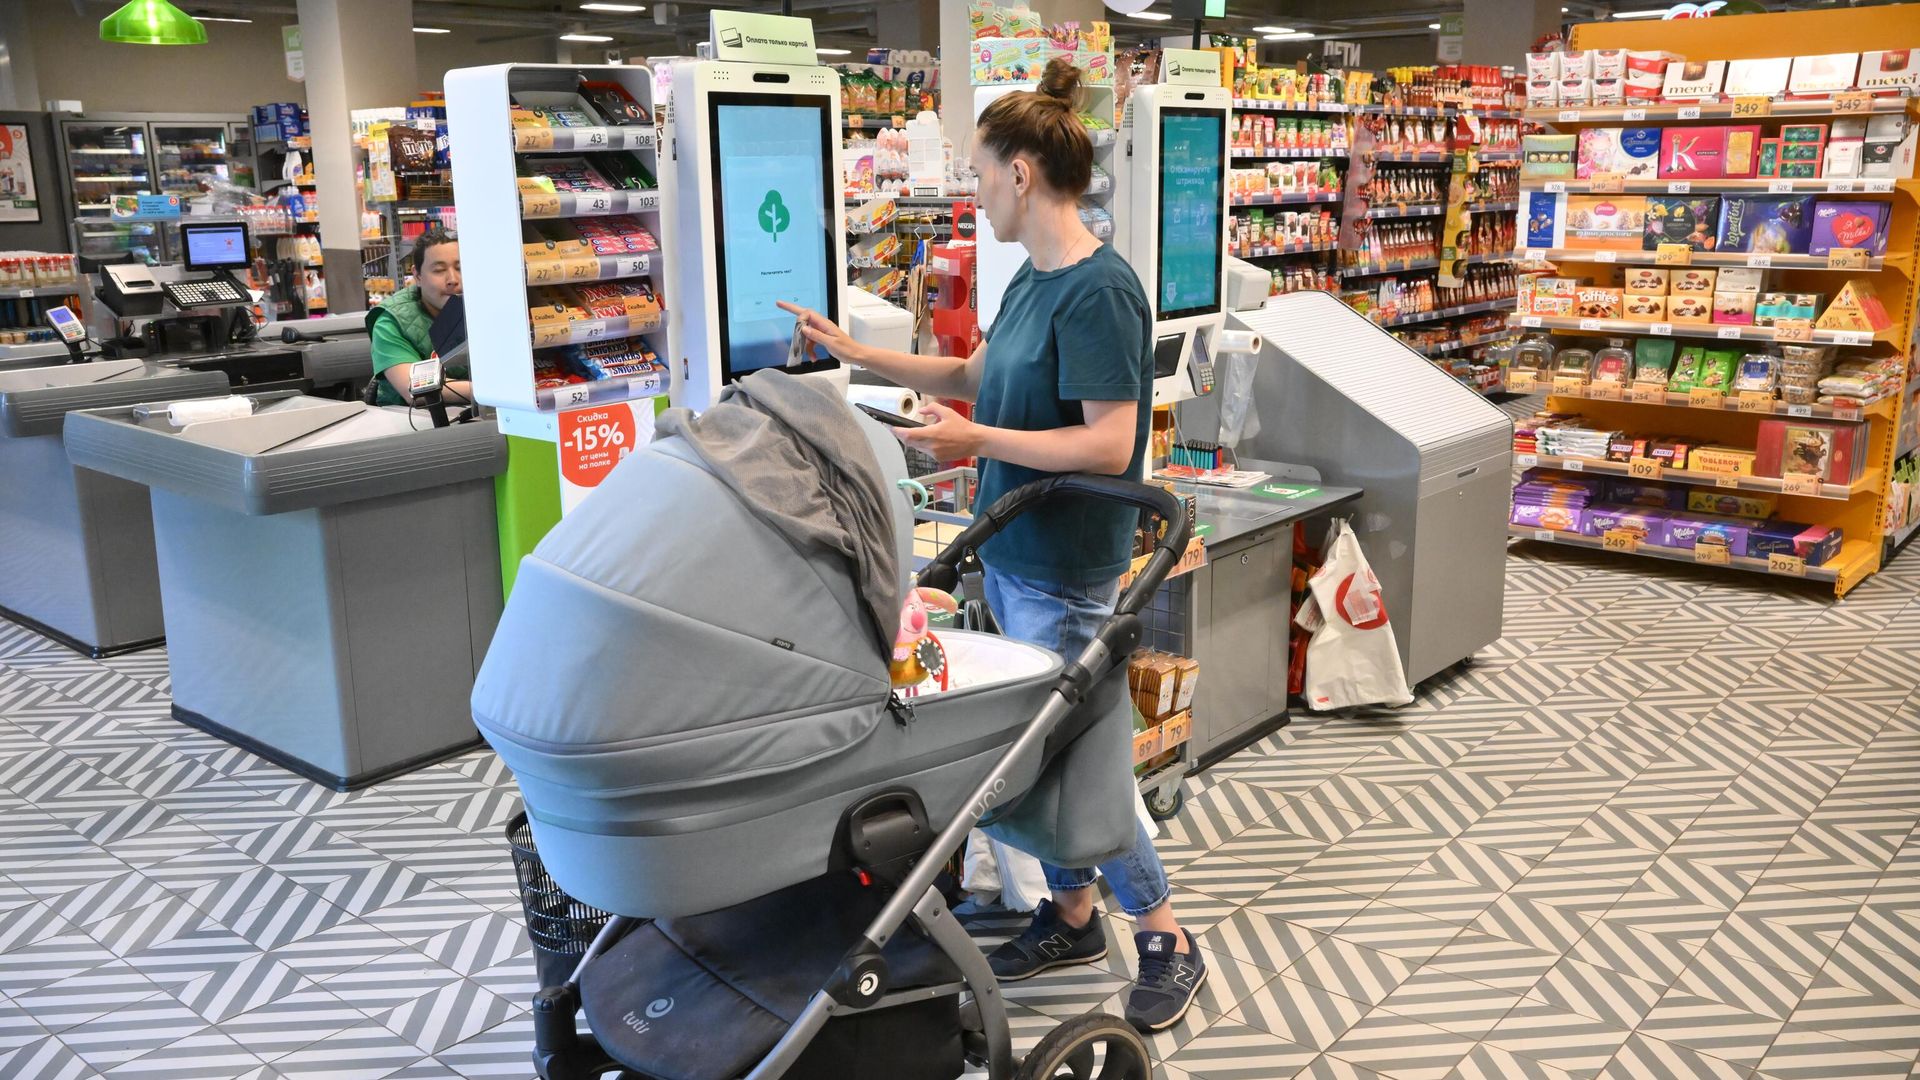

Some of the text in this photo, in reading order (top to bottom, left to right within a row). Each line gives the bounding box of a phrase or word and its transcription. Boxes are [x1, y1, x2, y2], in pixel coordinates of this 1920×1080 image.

[1866, 73, 1917, 86] merci
[1669, 83, 1713, 94] merci
[1734, 103, 1758, 114] 349
[1835, 98, 1861, 110] 349
[526, 136, 537, 144] 27
[590, 134, 602, 143] 43
[635, 136, 650, 144] 108
[592, 199, 604, 208] 43
[640, 196, 654, 206] 103
[533, 203, 544, 213] 27
[632, 261, 644, 270] 50
[536, 270, 548, 280] 27
[574, 266, 585, 276] 27
[1577, 290, 1619, 304] Toffifee
[1776, 328, 1801, 339] 229
[603, 352, 642, 366] SNICKERS
[612, 362, 652, 376] SNICKERS
[645, 380, 655, 390] 57
[572, 392, 583, 402] 52
[577, 412, 608, 422] Скидка
[564, 422, 625, 452] -15%
[590, 452, 608, 460] цены
[590, 459, 611, 468] полке
[1632, 464, 1652, 474] 109
[1517, 506, 1540, 515] Milka
[1594, 518, 1615, 528] Milka
[1673, 528, 1696, 539] Milka
[1605, 538, 1626, 548] 249
[1184, 548, 1200, 567] 179
[1771, 560, 1794, 572] 202
[1170, 725, 1182, 740] 79
[1138, 740, 1152, 758] 89
[1038, 934, 1072, 958] N
[1174, 964, 1196, 990] N
[622, 1010, 650, 1034] tutis
